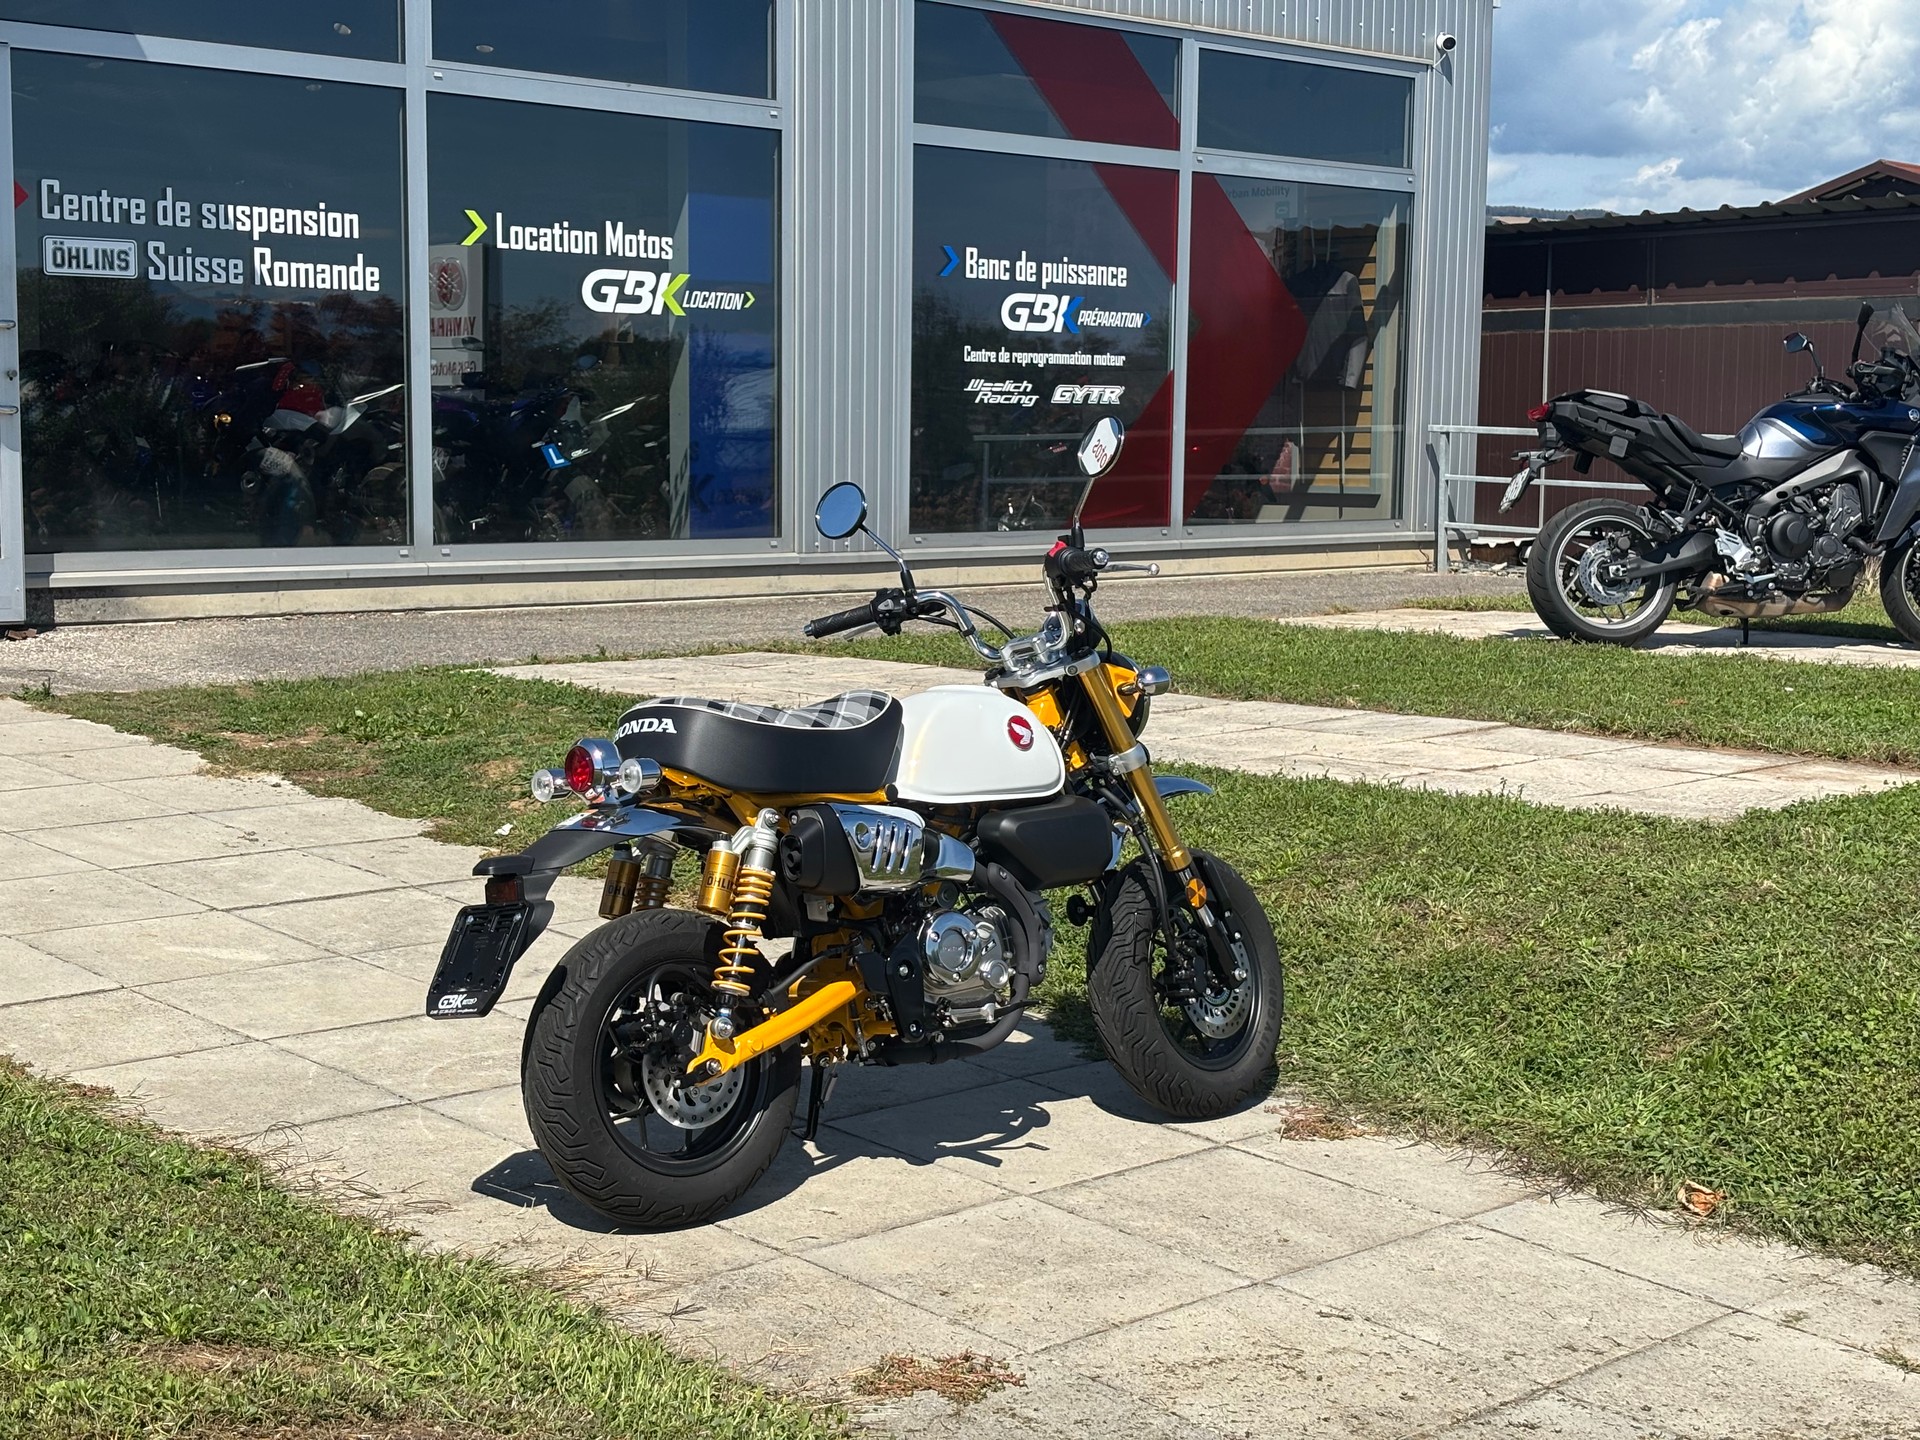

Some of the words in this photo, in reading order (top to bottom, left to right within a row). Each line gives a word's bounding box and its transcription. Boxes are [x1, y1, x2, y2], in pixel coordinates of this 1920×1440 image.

[1226, 189, 1249, 199] rban
[1251, 185, 1290, 198] Mobility
[41, 178, 146, 225] Centre
[156, 187, 191, 227] de
[201, 202, 360, 240] suspension
[496, 212, 598, 255] Location
[605, 220, 674, 260] Motos
[51, 240, 132, 272] ÖHLINS
[147, 240, 244, 285] Suisse
[253, 246, 381, 292] Romande
[965, 247, 1010, 280] Banc
[1015, 250, 1037, 282] de
[1041, 256, 1128, 290] puissance
[581, 268, 691, 316] GBK
[682, 290, 744, 310] LOCATION
[1001, 292, 1086, 334] GBK
[1077, 307, 1144, 329] PRÉPARATION
[963, 345, 997, 363] Centre
[998, 346, 1010, 363] de
[1012, 350, 1092, 368] reprogrammation
[1093, 352, 1126, 367] moteur
[964, 378, 1033, 392] Woolich
[975, 392, 1040, 407] Racing
[1051, 384, 1122, 405] GYTR
[548, 447, 565, 465] L
